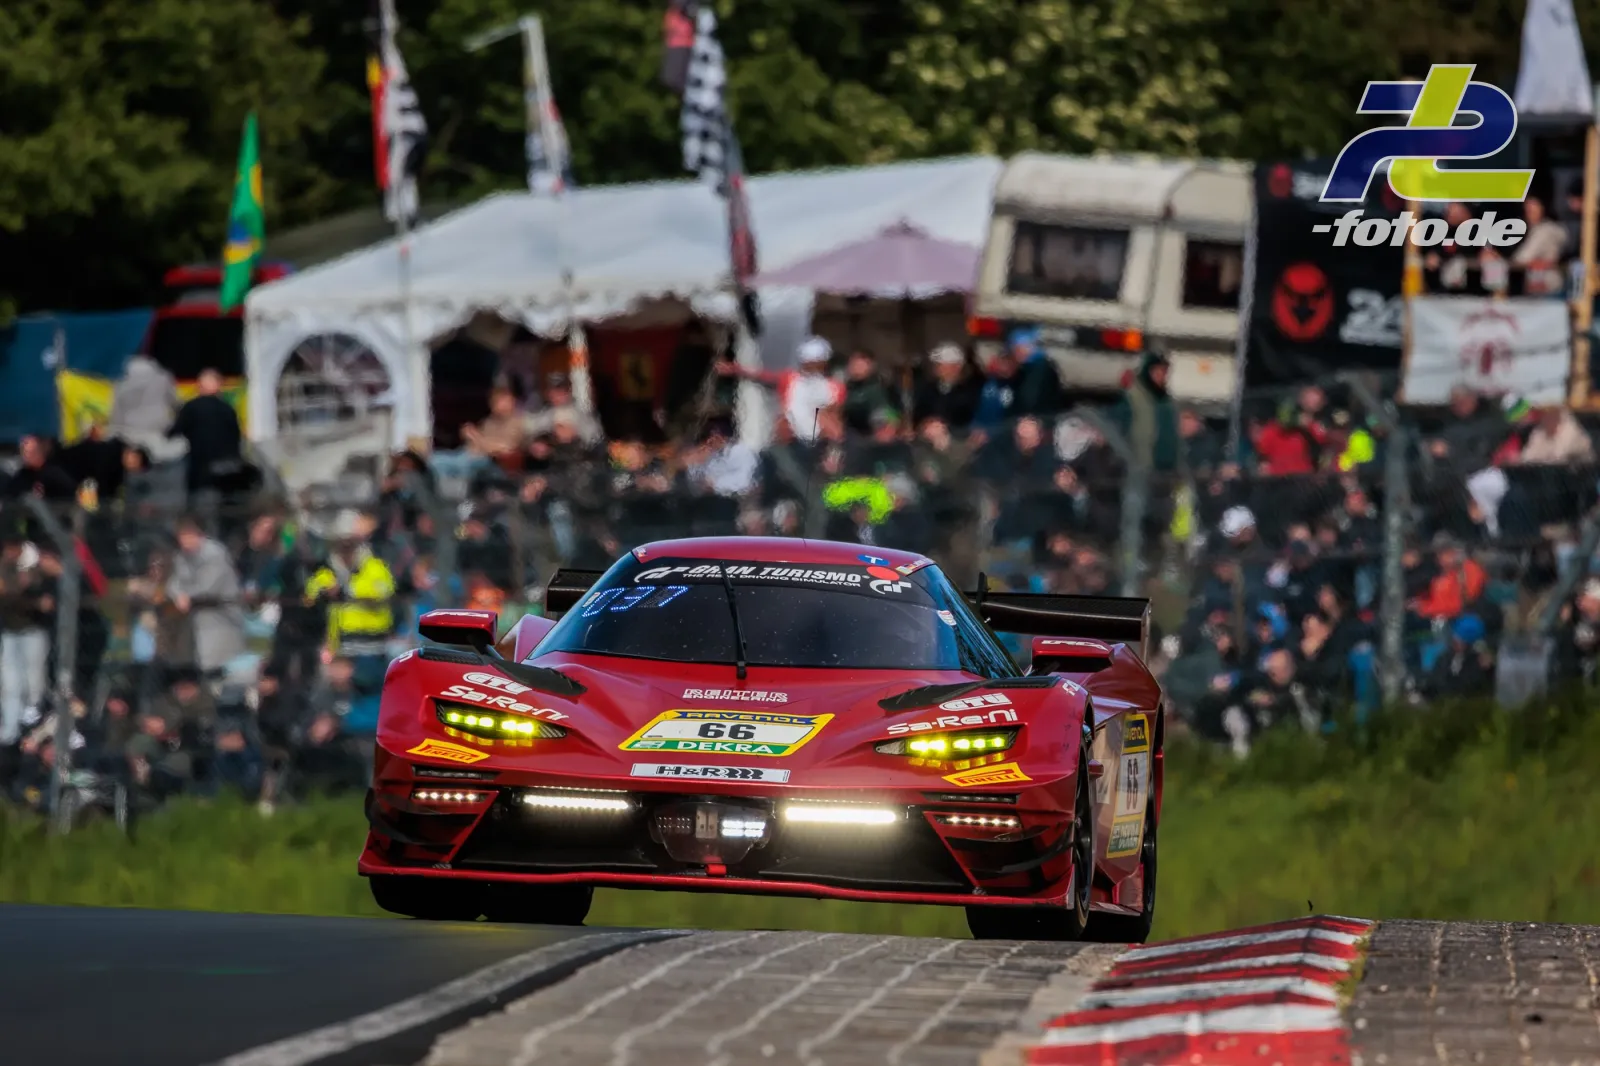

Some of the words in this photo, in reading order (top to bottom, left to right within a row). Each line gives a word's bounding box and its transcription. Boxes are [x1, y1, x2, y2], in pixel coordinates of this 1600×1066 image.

[688, 565, 757, 575] GRAN
[791, 577, 861, 588] SIMULATOR
[686, 712, 806, 724] RAVENOL
[697, 722, 757, 740] 66
[677, 740, 774, 754] DEKRA
